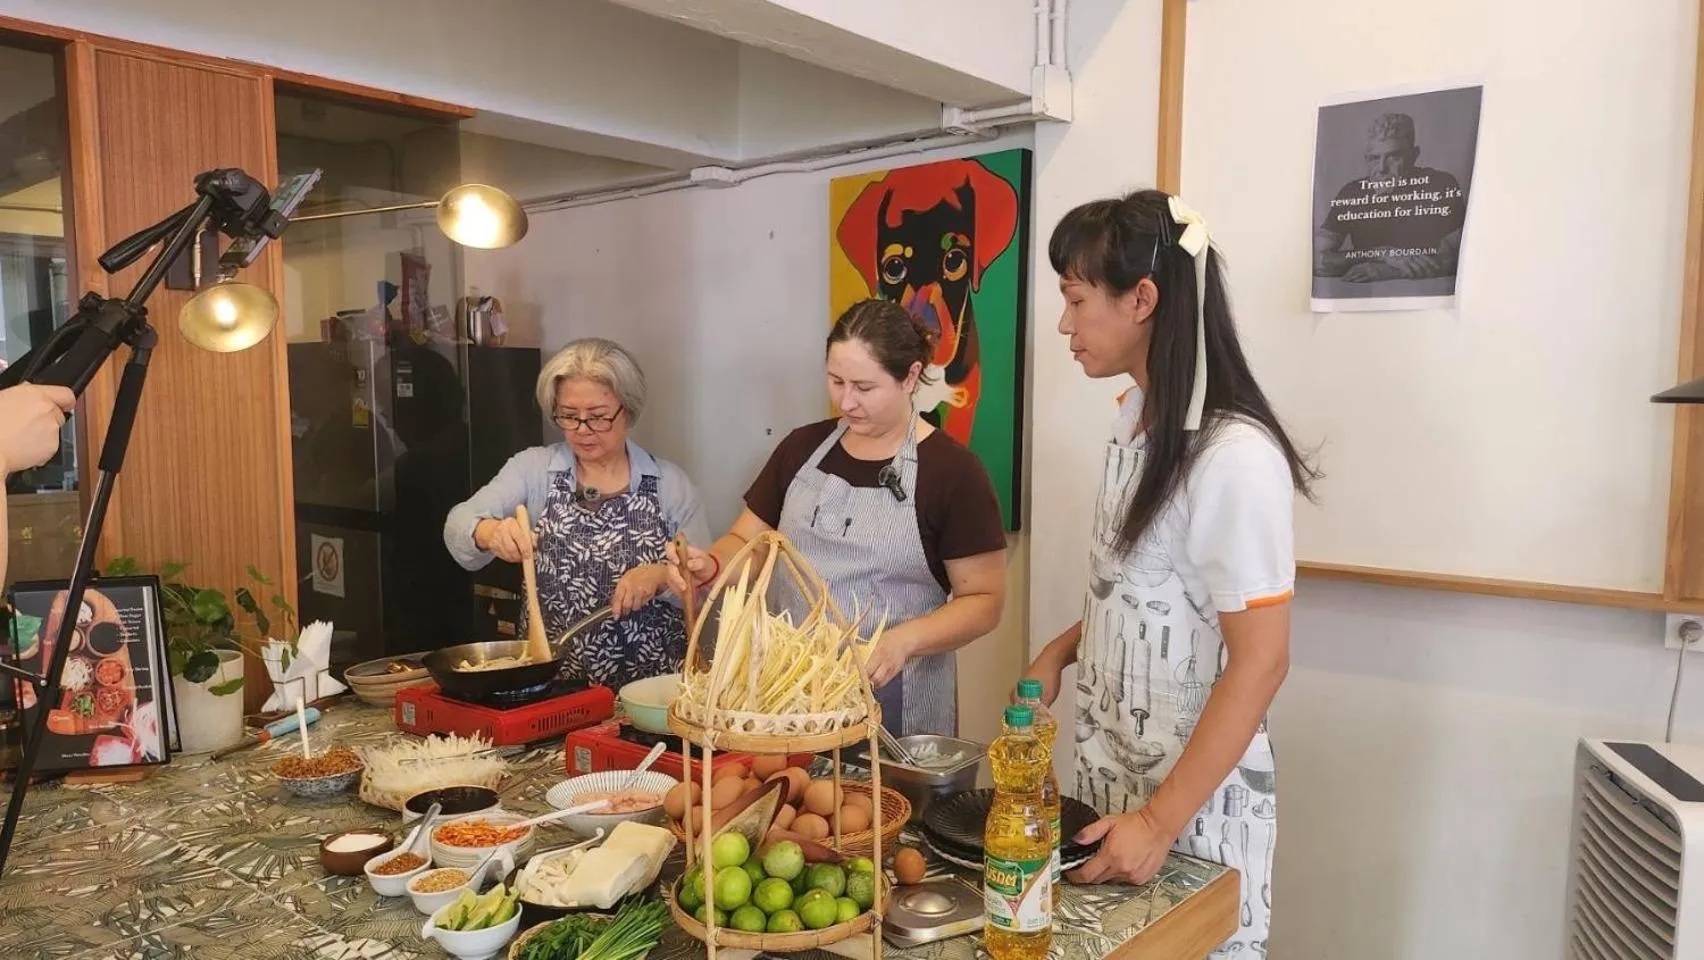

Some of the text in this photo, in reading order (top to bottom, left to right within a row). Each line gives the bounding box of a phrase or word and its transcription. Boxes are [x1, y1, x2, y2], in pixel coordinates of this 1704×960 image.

[1359, 175, 1430, 190] Travel is not
[1330, 194, 1369, 207] reward
[1371, 192, 1389, 204] for
[1445, 187, 1462, 198] it's
[1337, 204, 1452, 221] education for living.
[1345, 247, 1437, 259] ANTHONY BOURDAIN
